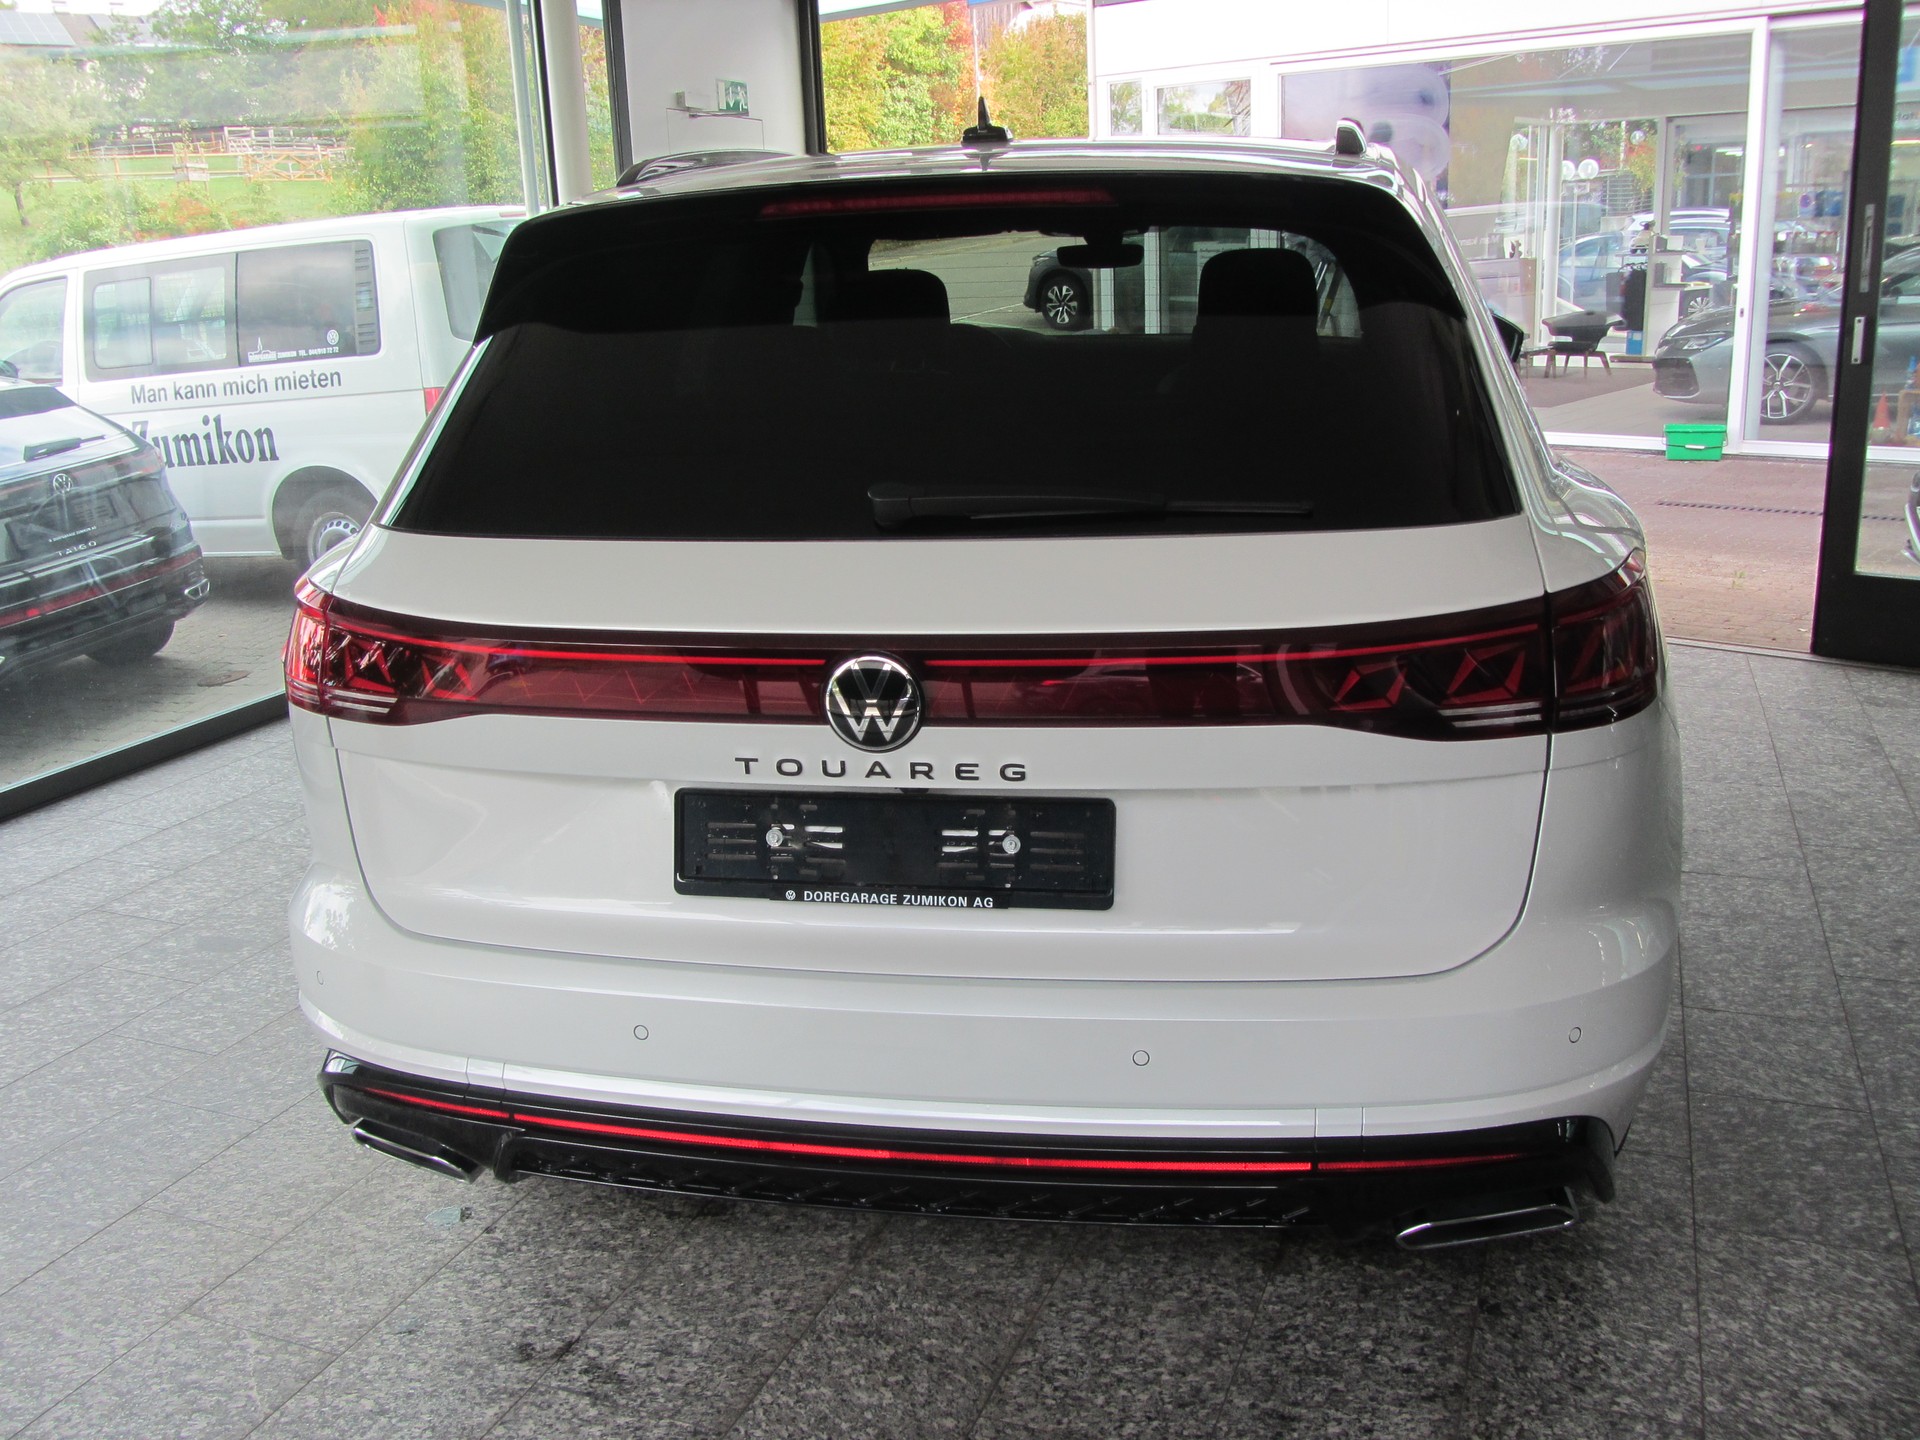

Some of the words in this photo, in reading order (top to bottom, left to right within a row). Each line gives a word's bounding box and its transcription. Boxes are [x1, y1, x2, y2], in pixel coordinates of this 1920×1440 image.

[131, 385, 168, 404] Man
[174, 381, 217, 400] kann
[223, 374, 268, 396] mich
[275, 369, 342, 391] mieten
[56, 540, 97, 557] TAIGO
[735, 757, 1027, 782] TOUAREG
[803, 890, 898, 905] DORFGARAGE
[902, 894, 968, 907] ZUMIKON
[973, 897, 994, 908] AG
